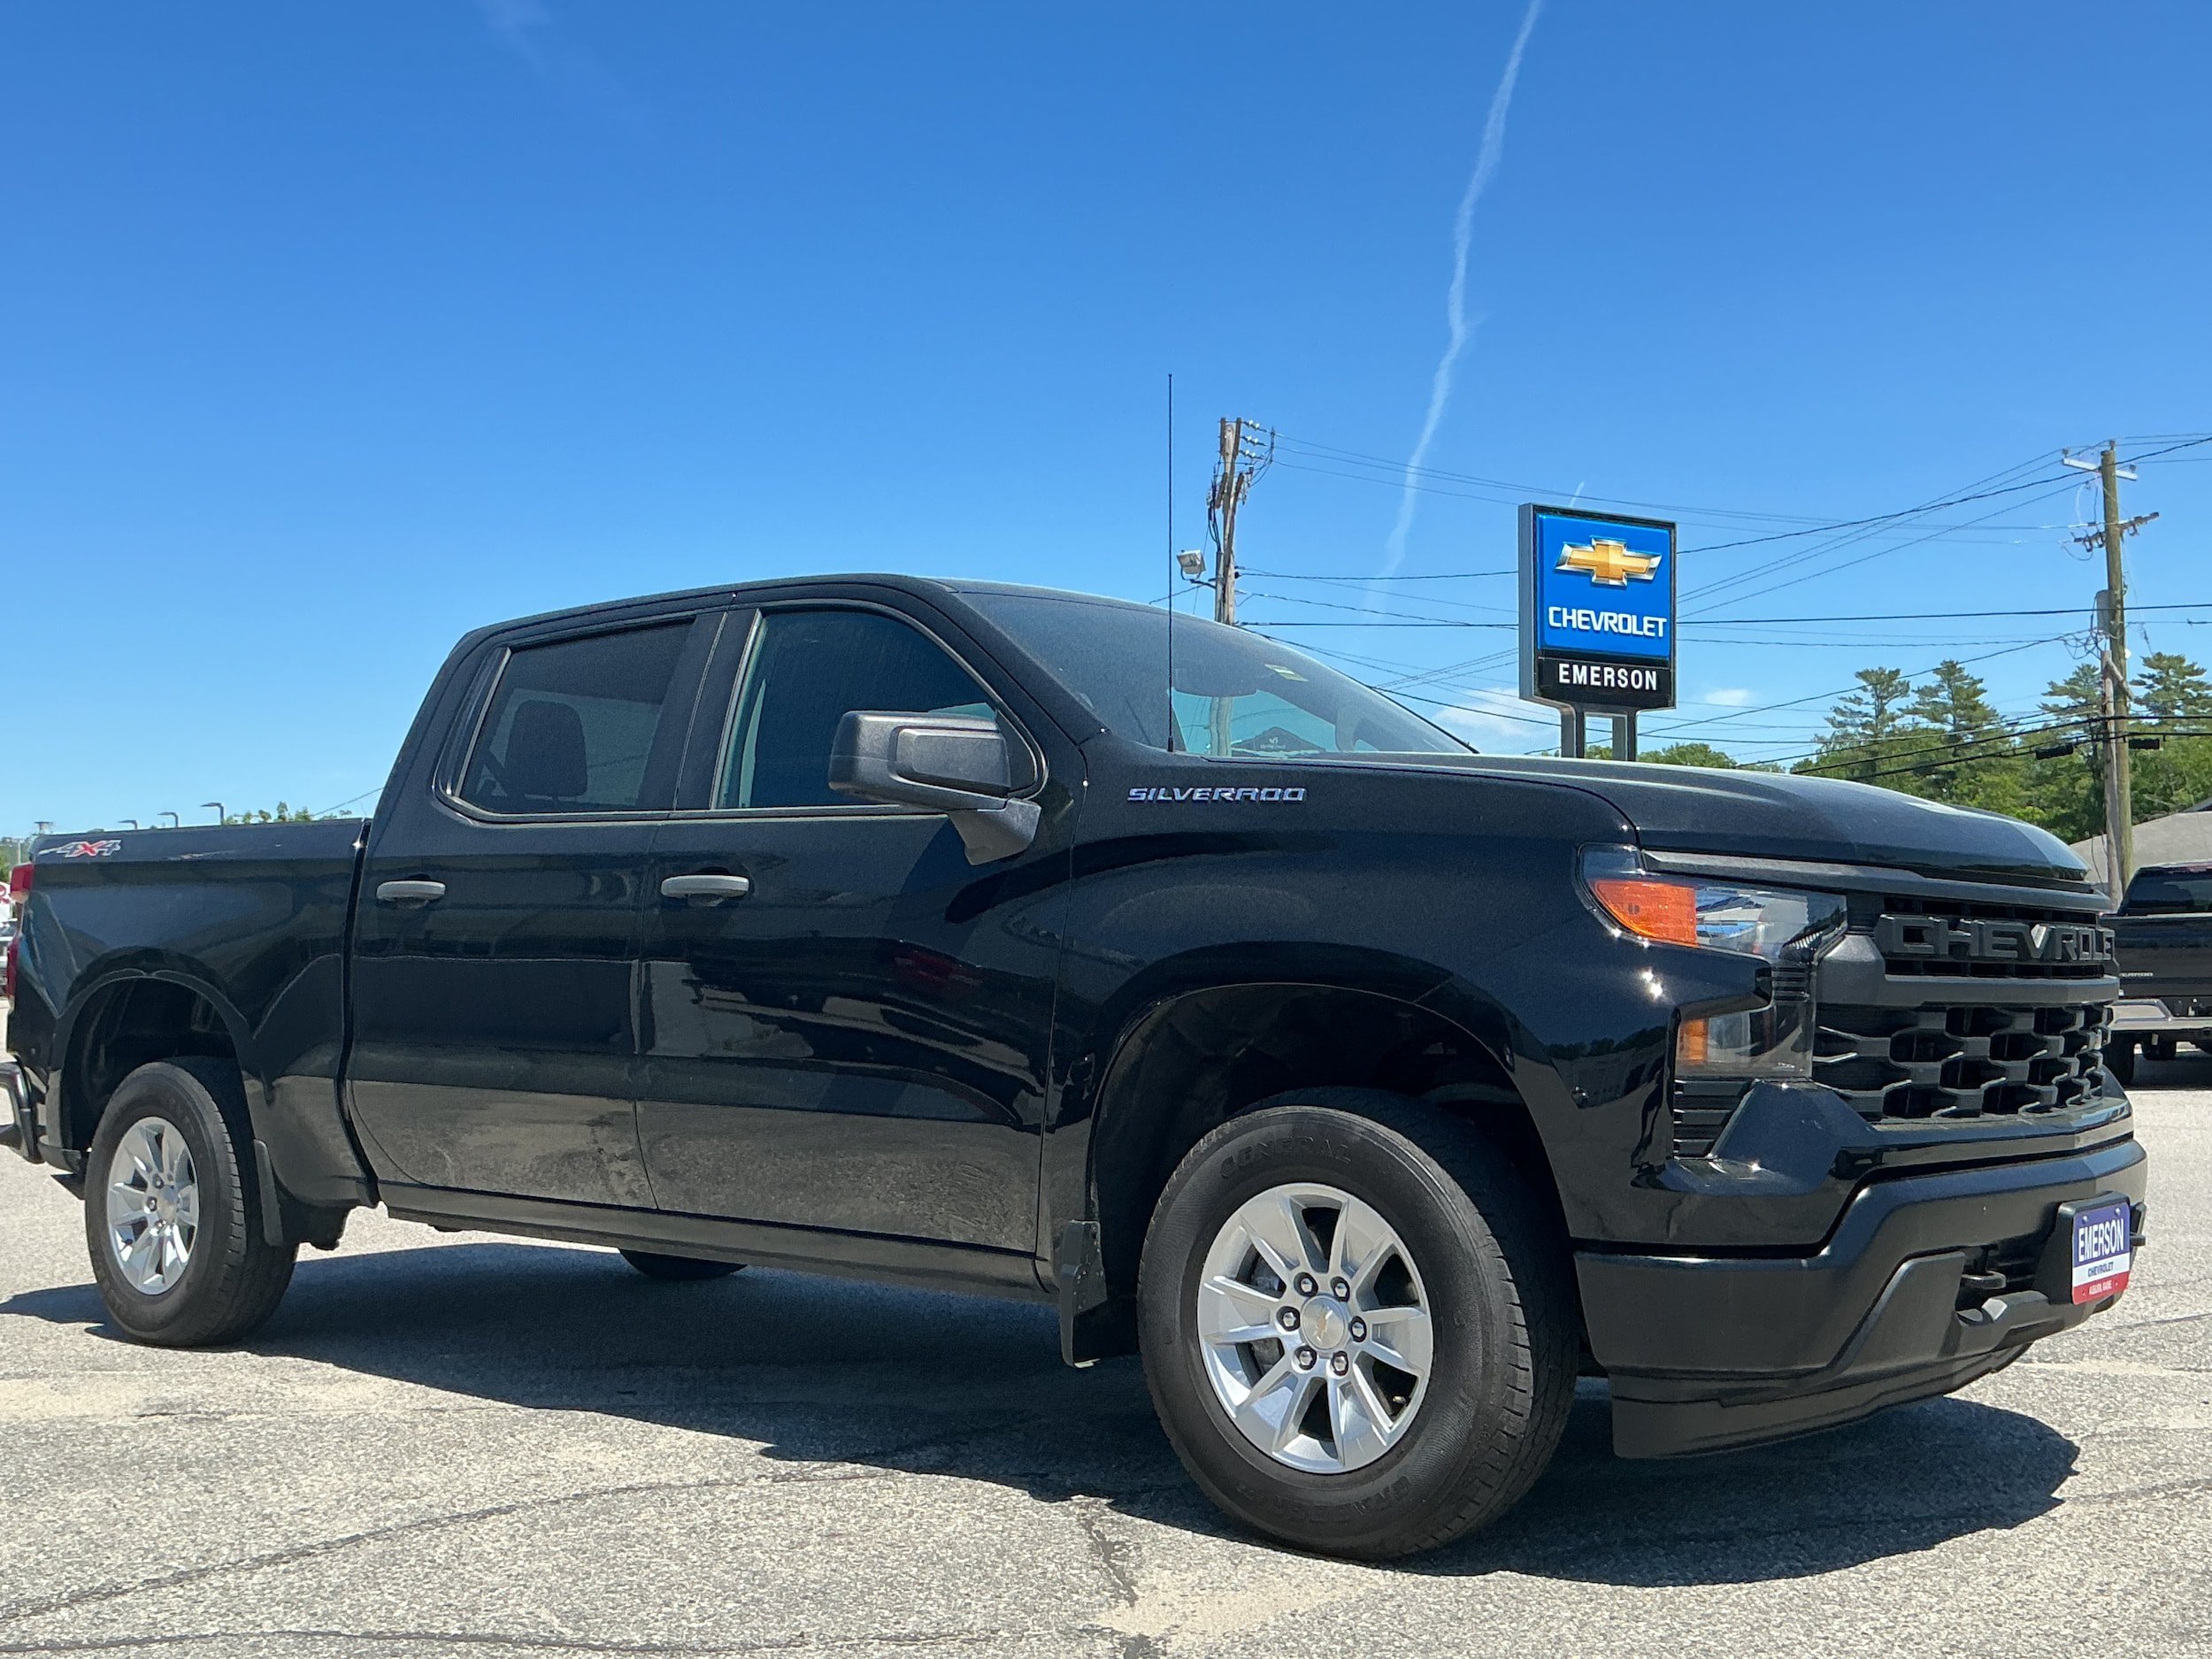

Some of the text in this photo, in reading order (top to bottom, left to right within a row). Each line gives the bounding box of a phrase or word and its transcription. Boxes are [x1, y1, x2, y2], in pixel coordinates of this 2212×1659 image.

[1548, 606, 1667, 637] CHEVROLET
[1559, 664, 1657, 691] EMERSON
[1127, 787, 1306, 802] SILVERADO
[1874, 913, 2115, 961] CHEVROLE
[2078, 1218, 2124, 1263] EMERSON
